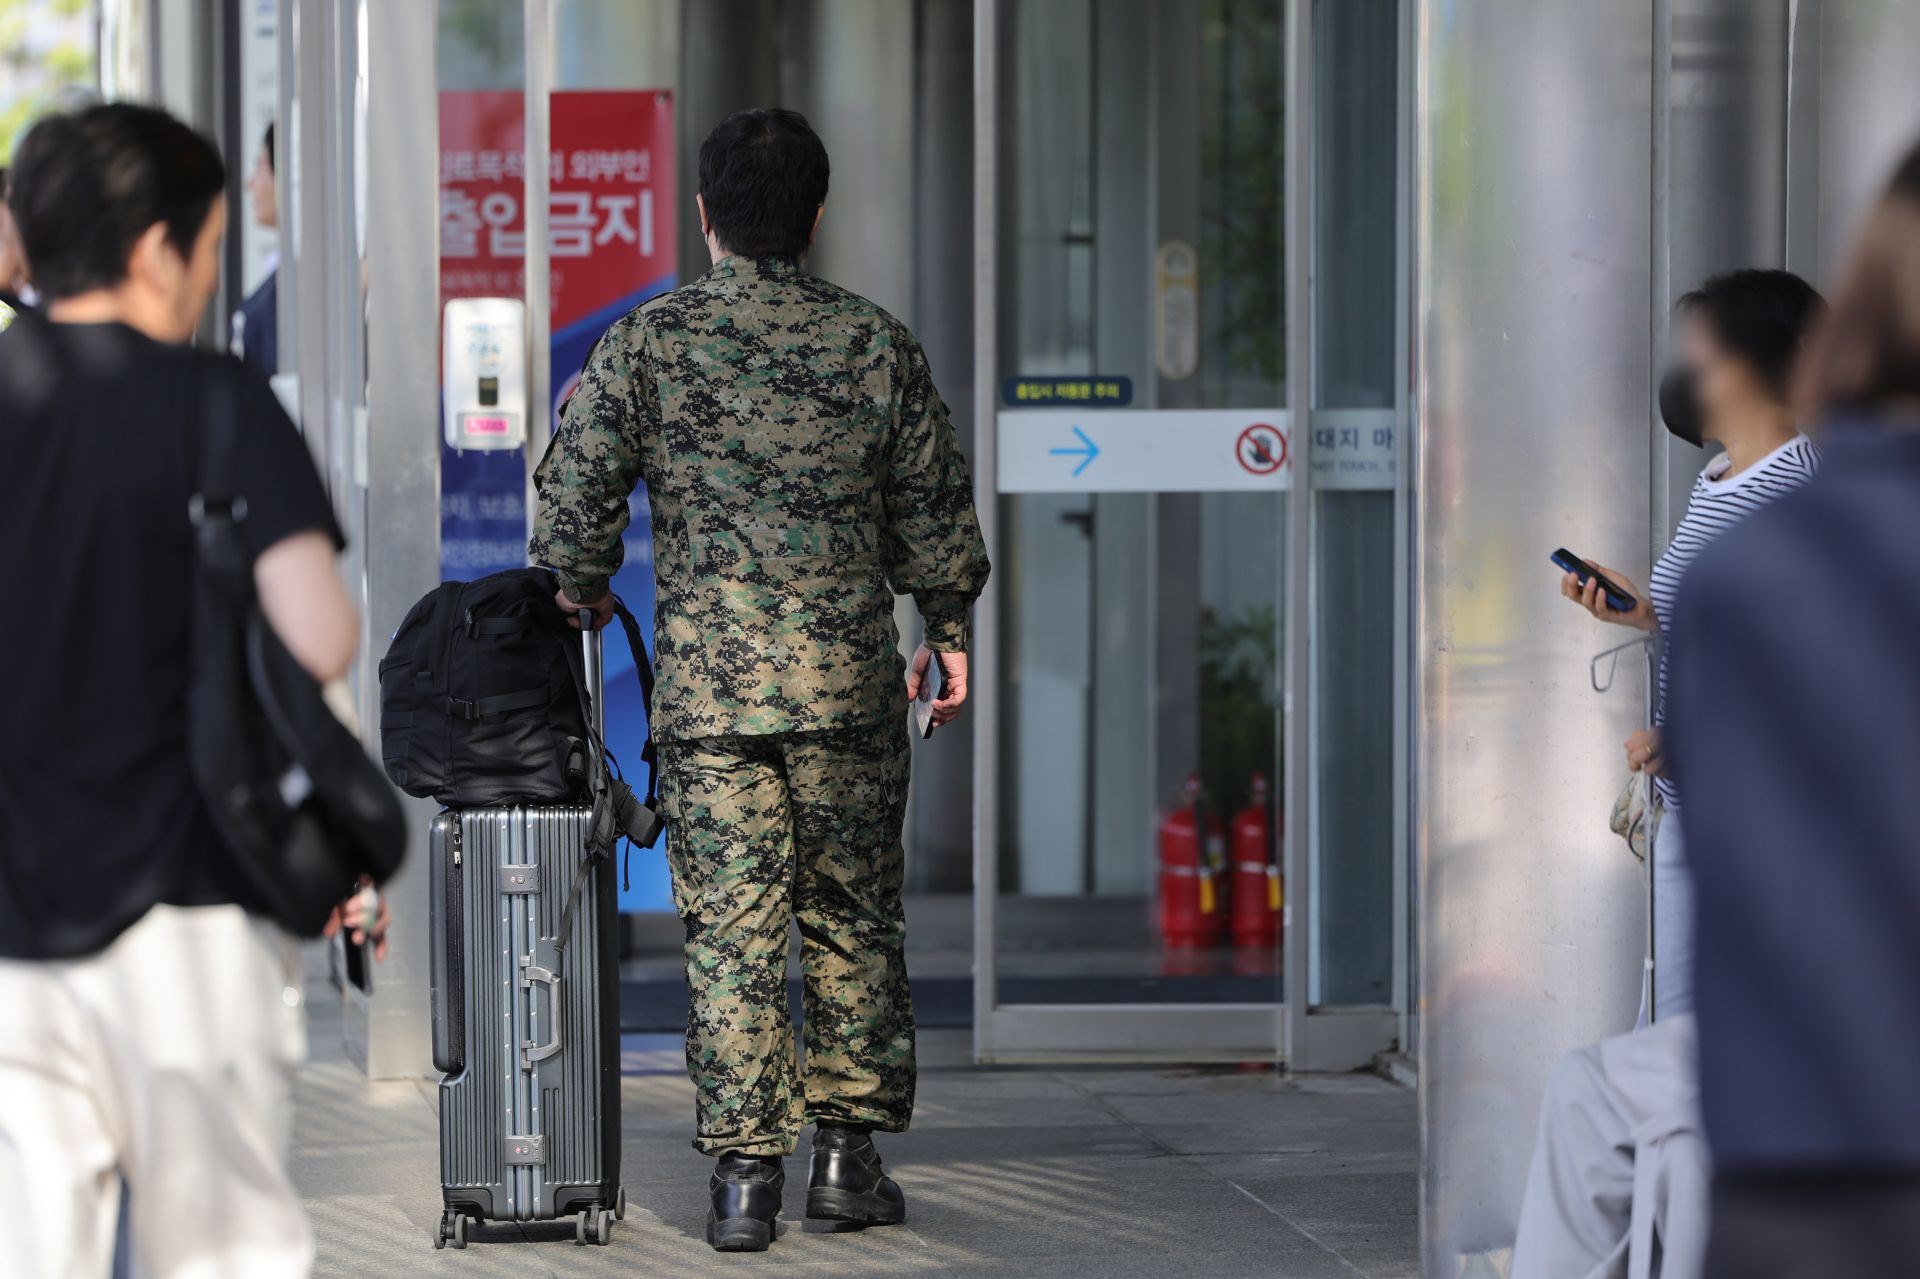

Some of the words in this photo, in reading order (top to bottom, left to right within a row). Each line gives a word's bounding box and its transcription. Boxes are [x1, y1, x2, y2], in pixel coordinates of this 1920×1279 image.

[570, 149, 649, 183] 외부인
[440, 187, 654, 257] 출입금지
[1309, 427, 1358, 451] 대지
